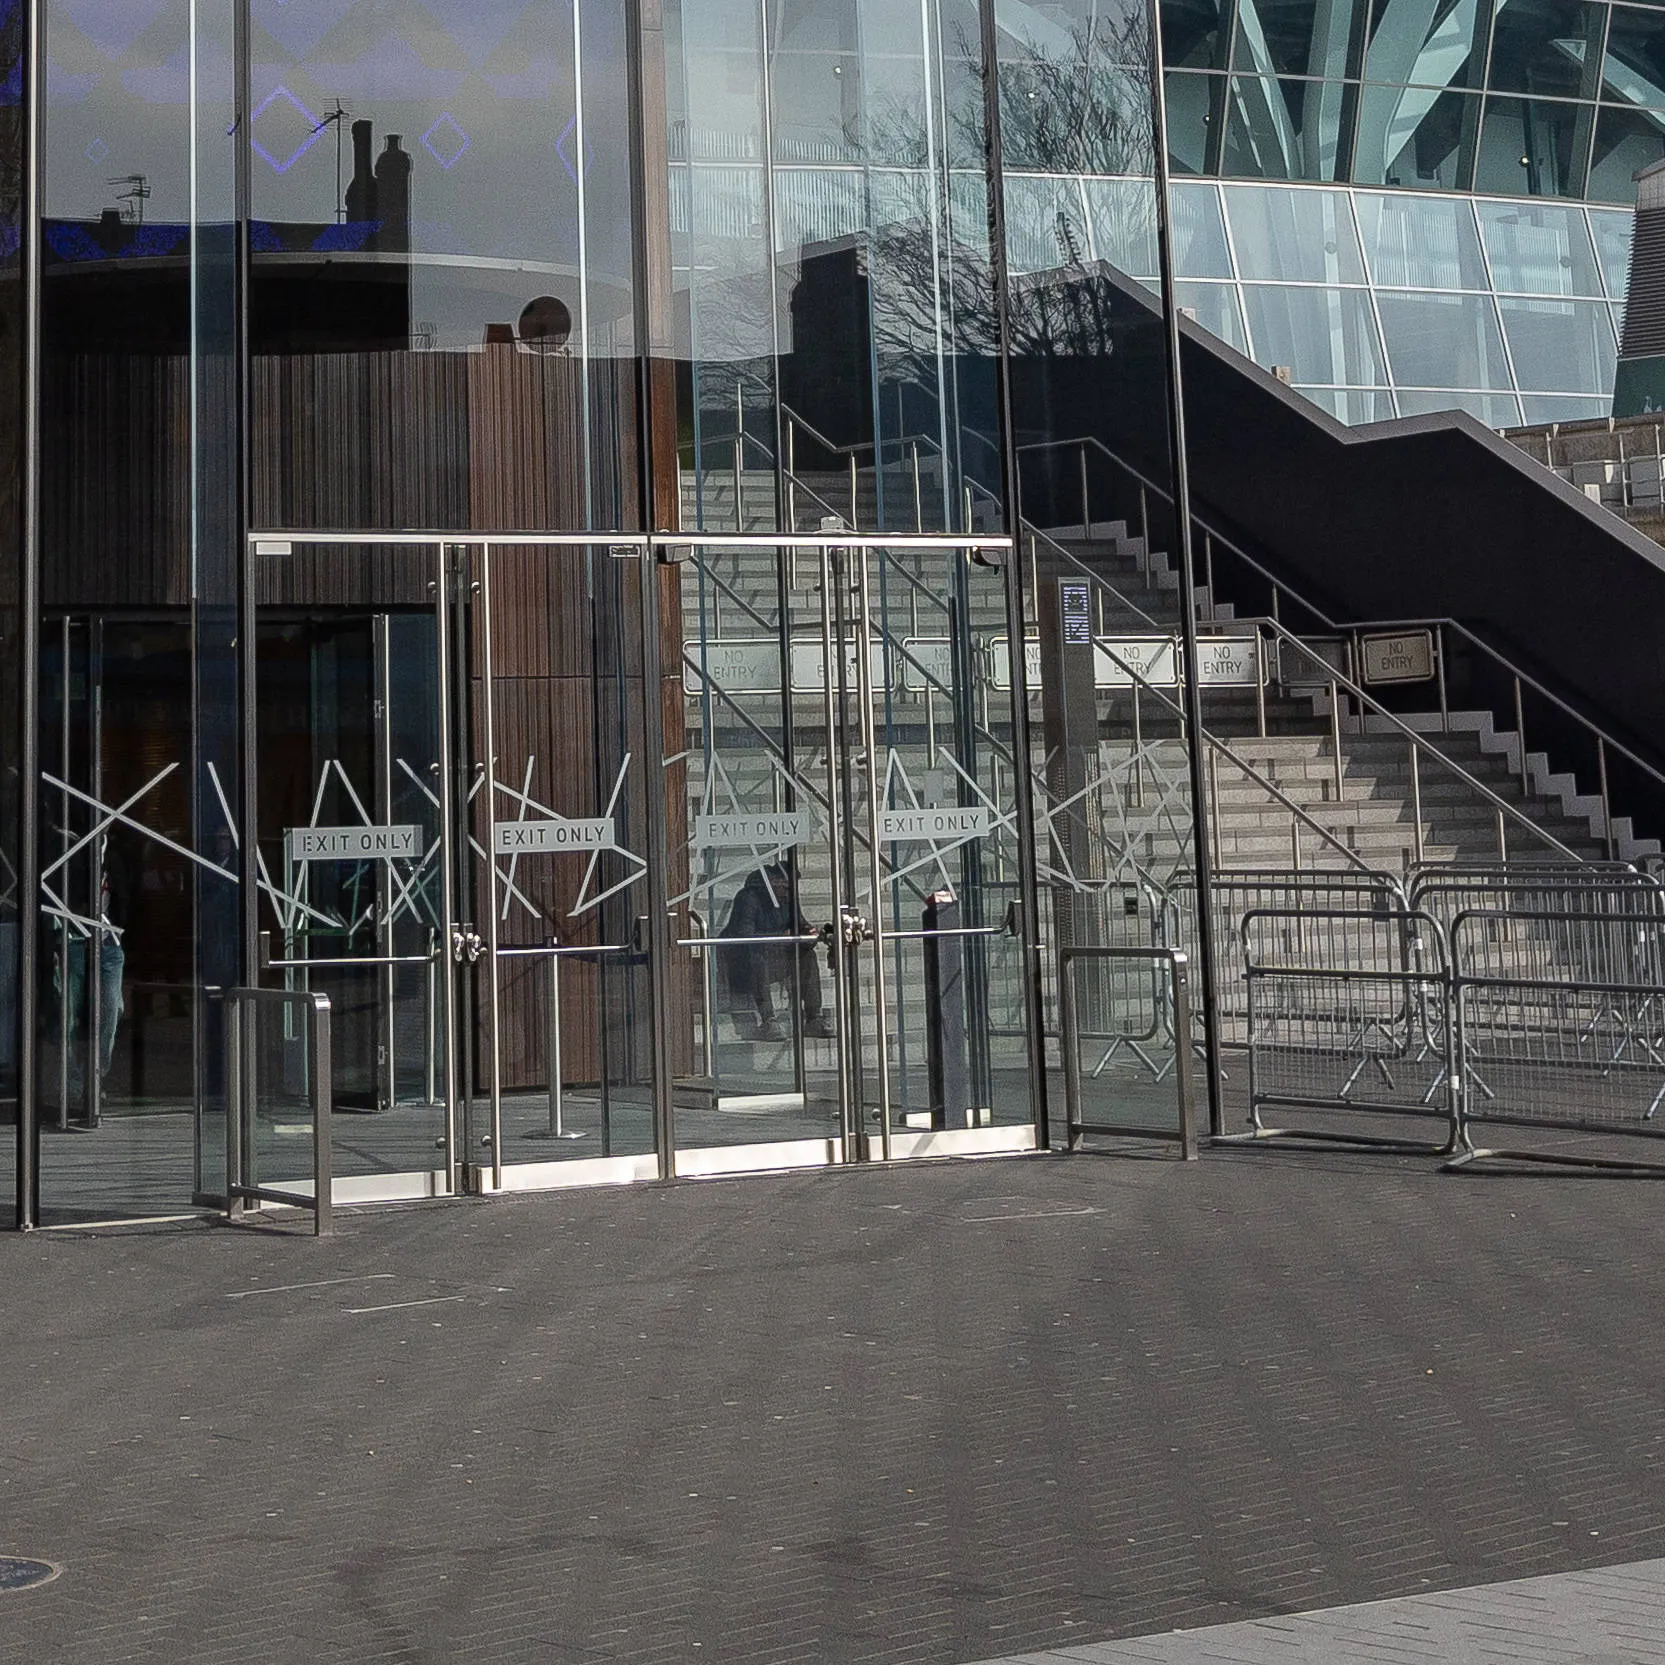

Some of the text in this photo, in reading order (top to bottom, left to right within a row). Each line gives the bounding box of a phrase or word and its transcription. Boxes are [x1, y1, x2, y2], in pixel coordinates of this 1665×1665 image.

[1123, 646, 1140, 659] NO
[1213, 646, 1231, 659] NO
[1389, 641, 1404, 654] NO
[724, 650, 744, 664] NO
[1382, 655, 1414, 671] ENTRY
[713, 666, 757, 680] ENTRY
[1114, 662, 1151, 676] ETRY
[1203, 661, 1242, 675] ENTRY
[708, 819, 800, 837] EXIT ONLY
[884, 815, 979, 833] EXIT ONLY
[302, 833, 413, 853] EXIT ONLY
[502, 826, 605, 846] EXIT ONLY
